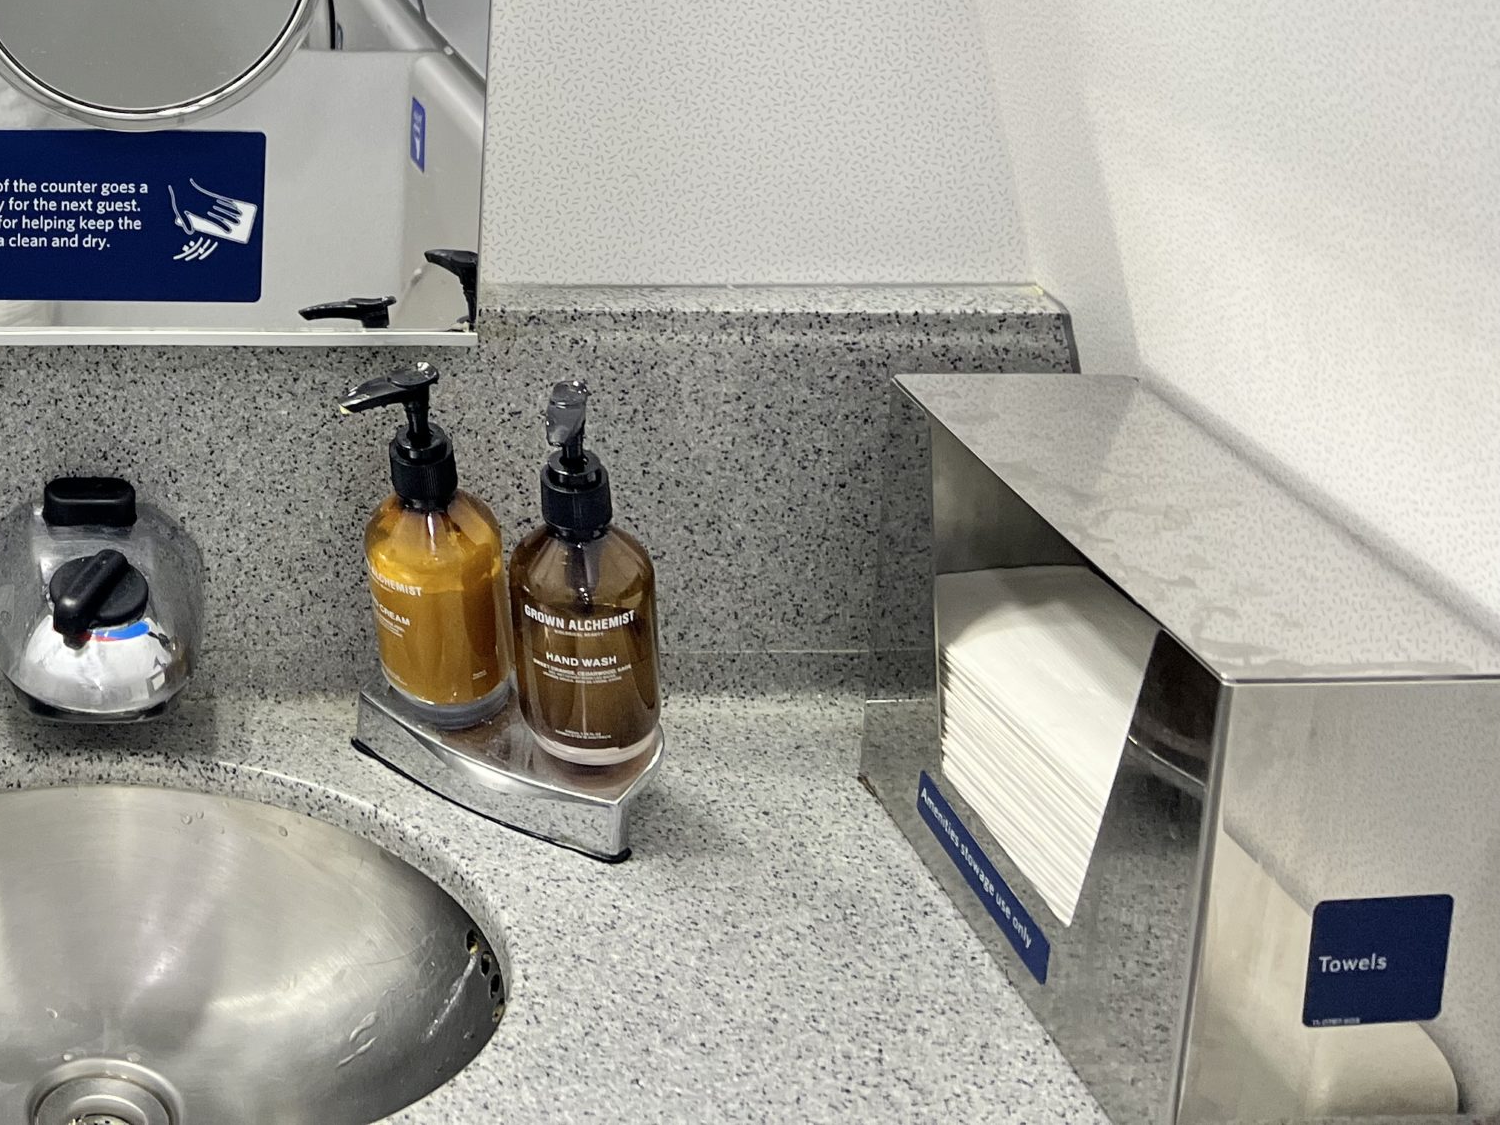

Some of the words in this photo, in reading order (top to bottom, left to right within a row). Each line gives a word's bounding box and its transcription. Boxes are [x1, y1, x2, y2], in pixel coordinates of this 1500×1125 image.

[13, 180, 37, 193] the
[41, 181, 98, 194] counter
[100, 183, 136, 196] goes
[139, 183, 149, 194] a
[8, 197, 30, 211] for
[33, 198, 57, 211] the
[61, 199, 93, 211] next
[96, 199, 141, 214] guest.
[22, 215, 76, 232] helping
[79, 216, 114, 232] keep
[118, 217, 142, 230] the
[8, 233, 48, 247] clean
[51, 234, 79, 247] and
[82, 234, 111, 250] dry.
[370, 565, 422, 597] LCHEMIST
[524, 604, 565, 629] GROWN
[568, 609, 635, 631] ALCHEMIST
[545, 651, 579, 667] HAND
[581, 655, 617, 668] WASH
[920, 787, 960, 849] Amenities
[960, 843, 995, 897] stowage
[995, 892, 1012, 920] use
[1012, 916, 1033, 950] only
[1318, 952, 1388, 973] Towels
